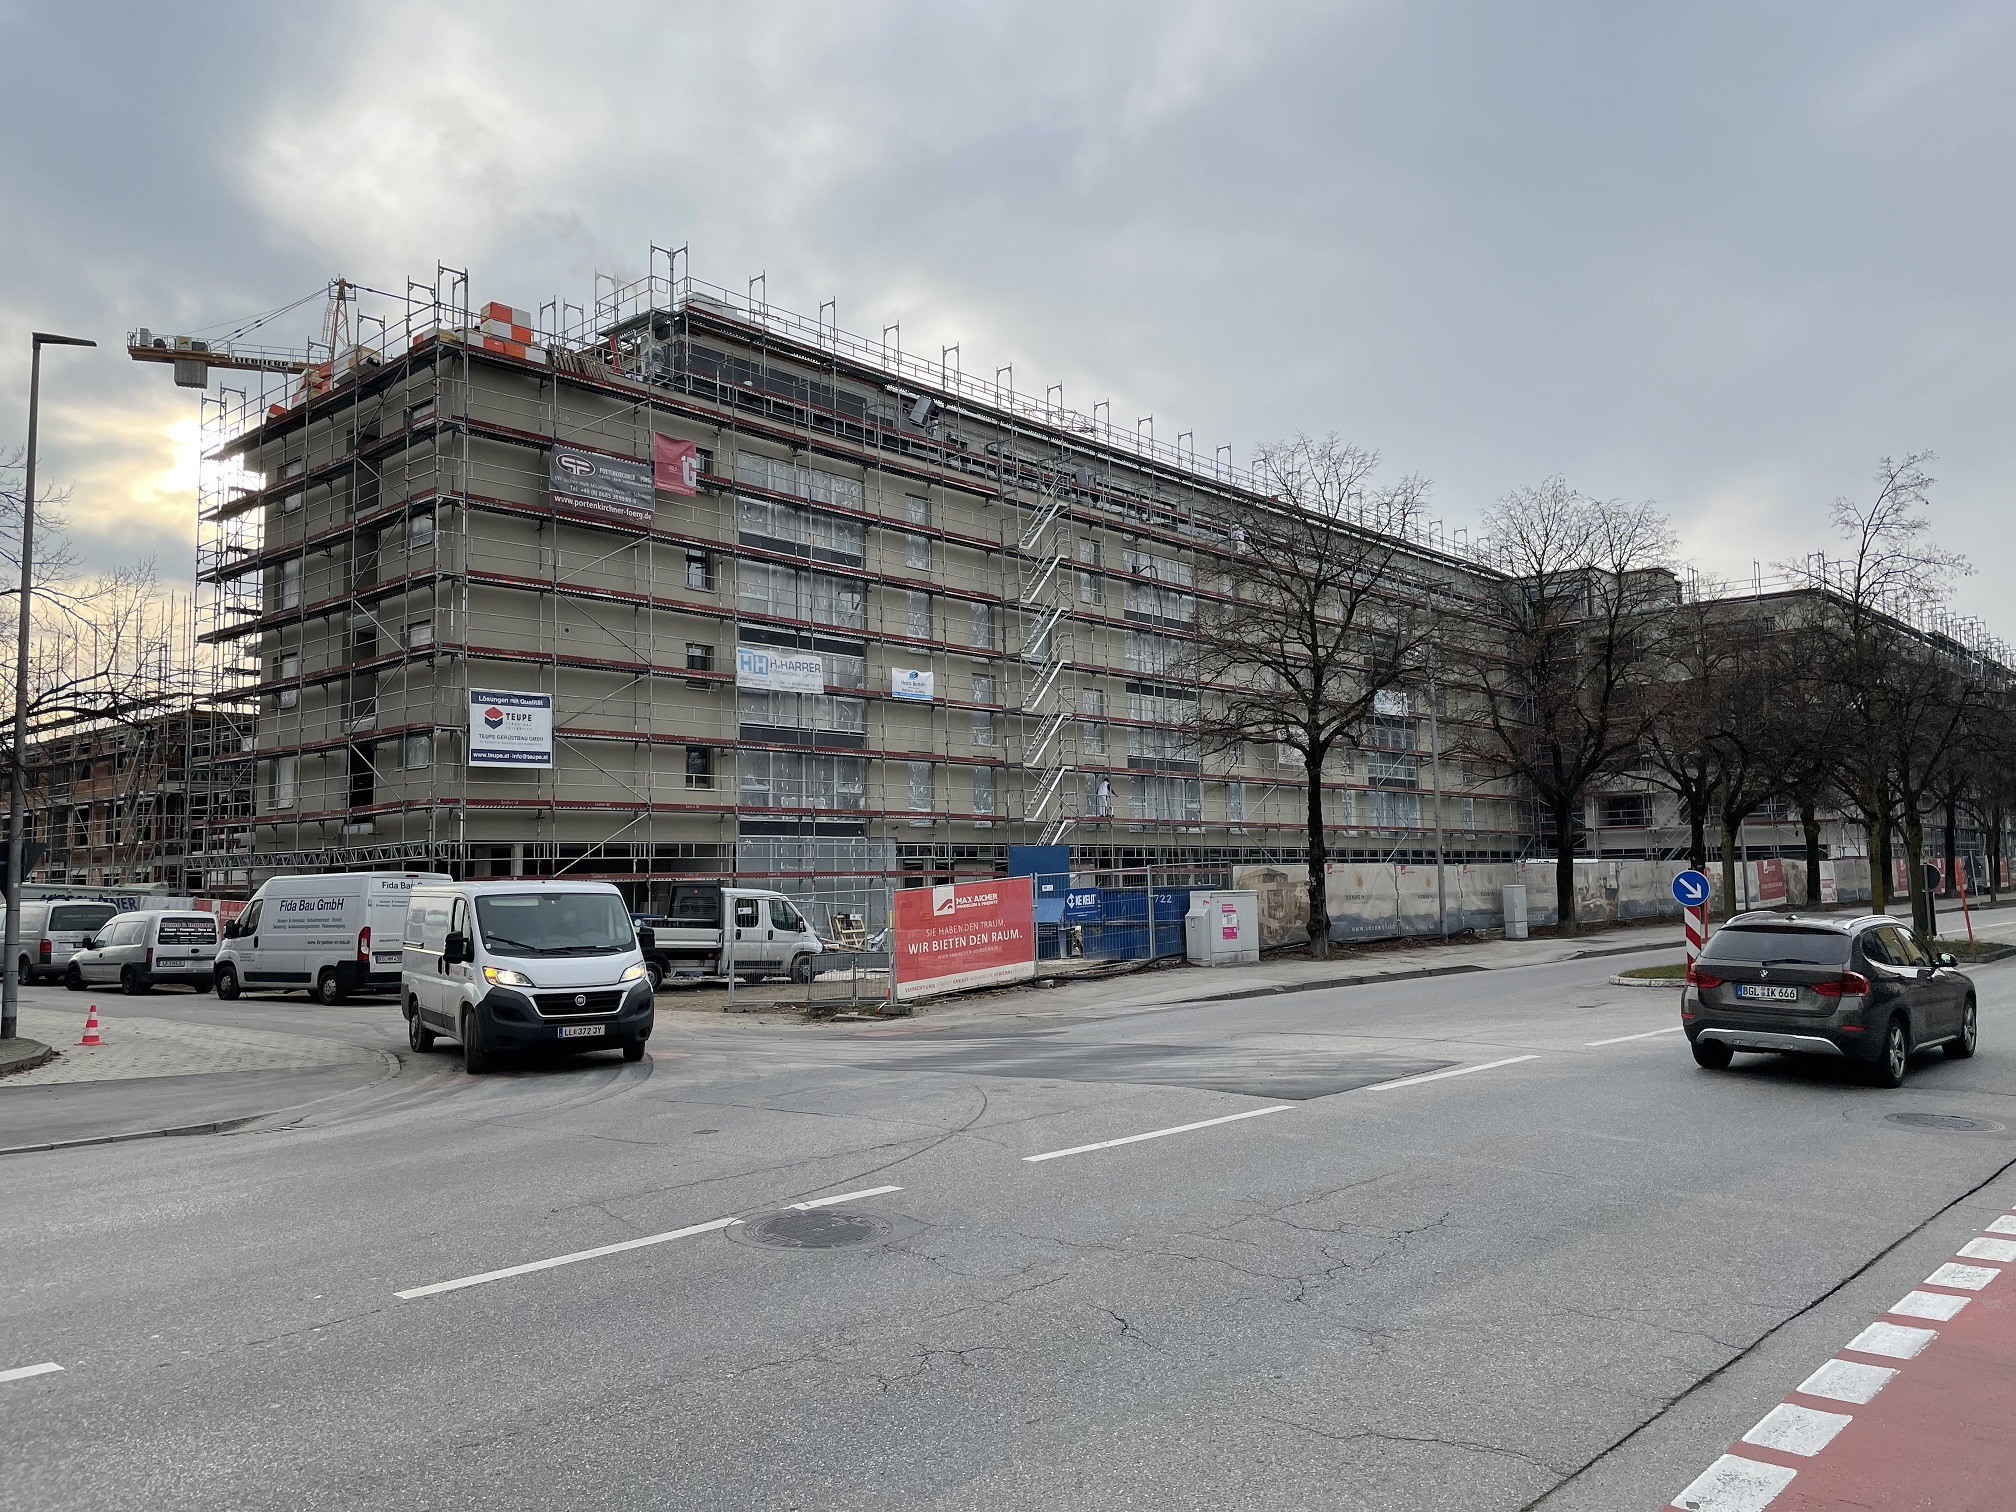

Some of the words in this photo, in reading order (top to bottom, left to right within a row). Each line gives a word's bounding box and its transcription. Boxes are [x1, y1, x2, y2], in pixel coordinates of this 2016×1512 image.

[554, 495, 652, 520] www.portenkirchner-foerg.de
[478, 695, 509, 704] Lösungen
[519, 698, 544, 706] Qualität
[505, 713, 532, 722] TEUPE
[382, 881, 399, 889] Fida
[956, 896, 973, 904] MAX
[974, 892, 998, 903] AICHER
[279, 900, 297, 912] Fida
[299, 899, 316, 911] Bau
[316, 898, 345, 911] GmbH
[925, 927, 937, 938] SIE
[938, 923, 963, 936] HABEN
[963, 922, 979, 932] DEN
[980, 919, 1006, 929] TRAUM,
[908, 942, 929, 955] WIR
[932, 936, 967, 952] BIETEN
[969, 933, 988, 946] DEN
[991, 928, 1023, 943] RAUM.
[1743, 987, 1760, 997] BGL
[1778, 989, 1795, 998] 666
[577, 1027, 592, 1035] 372
